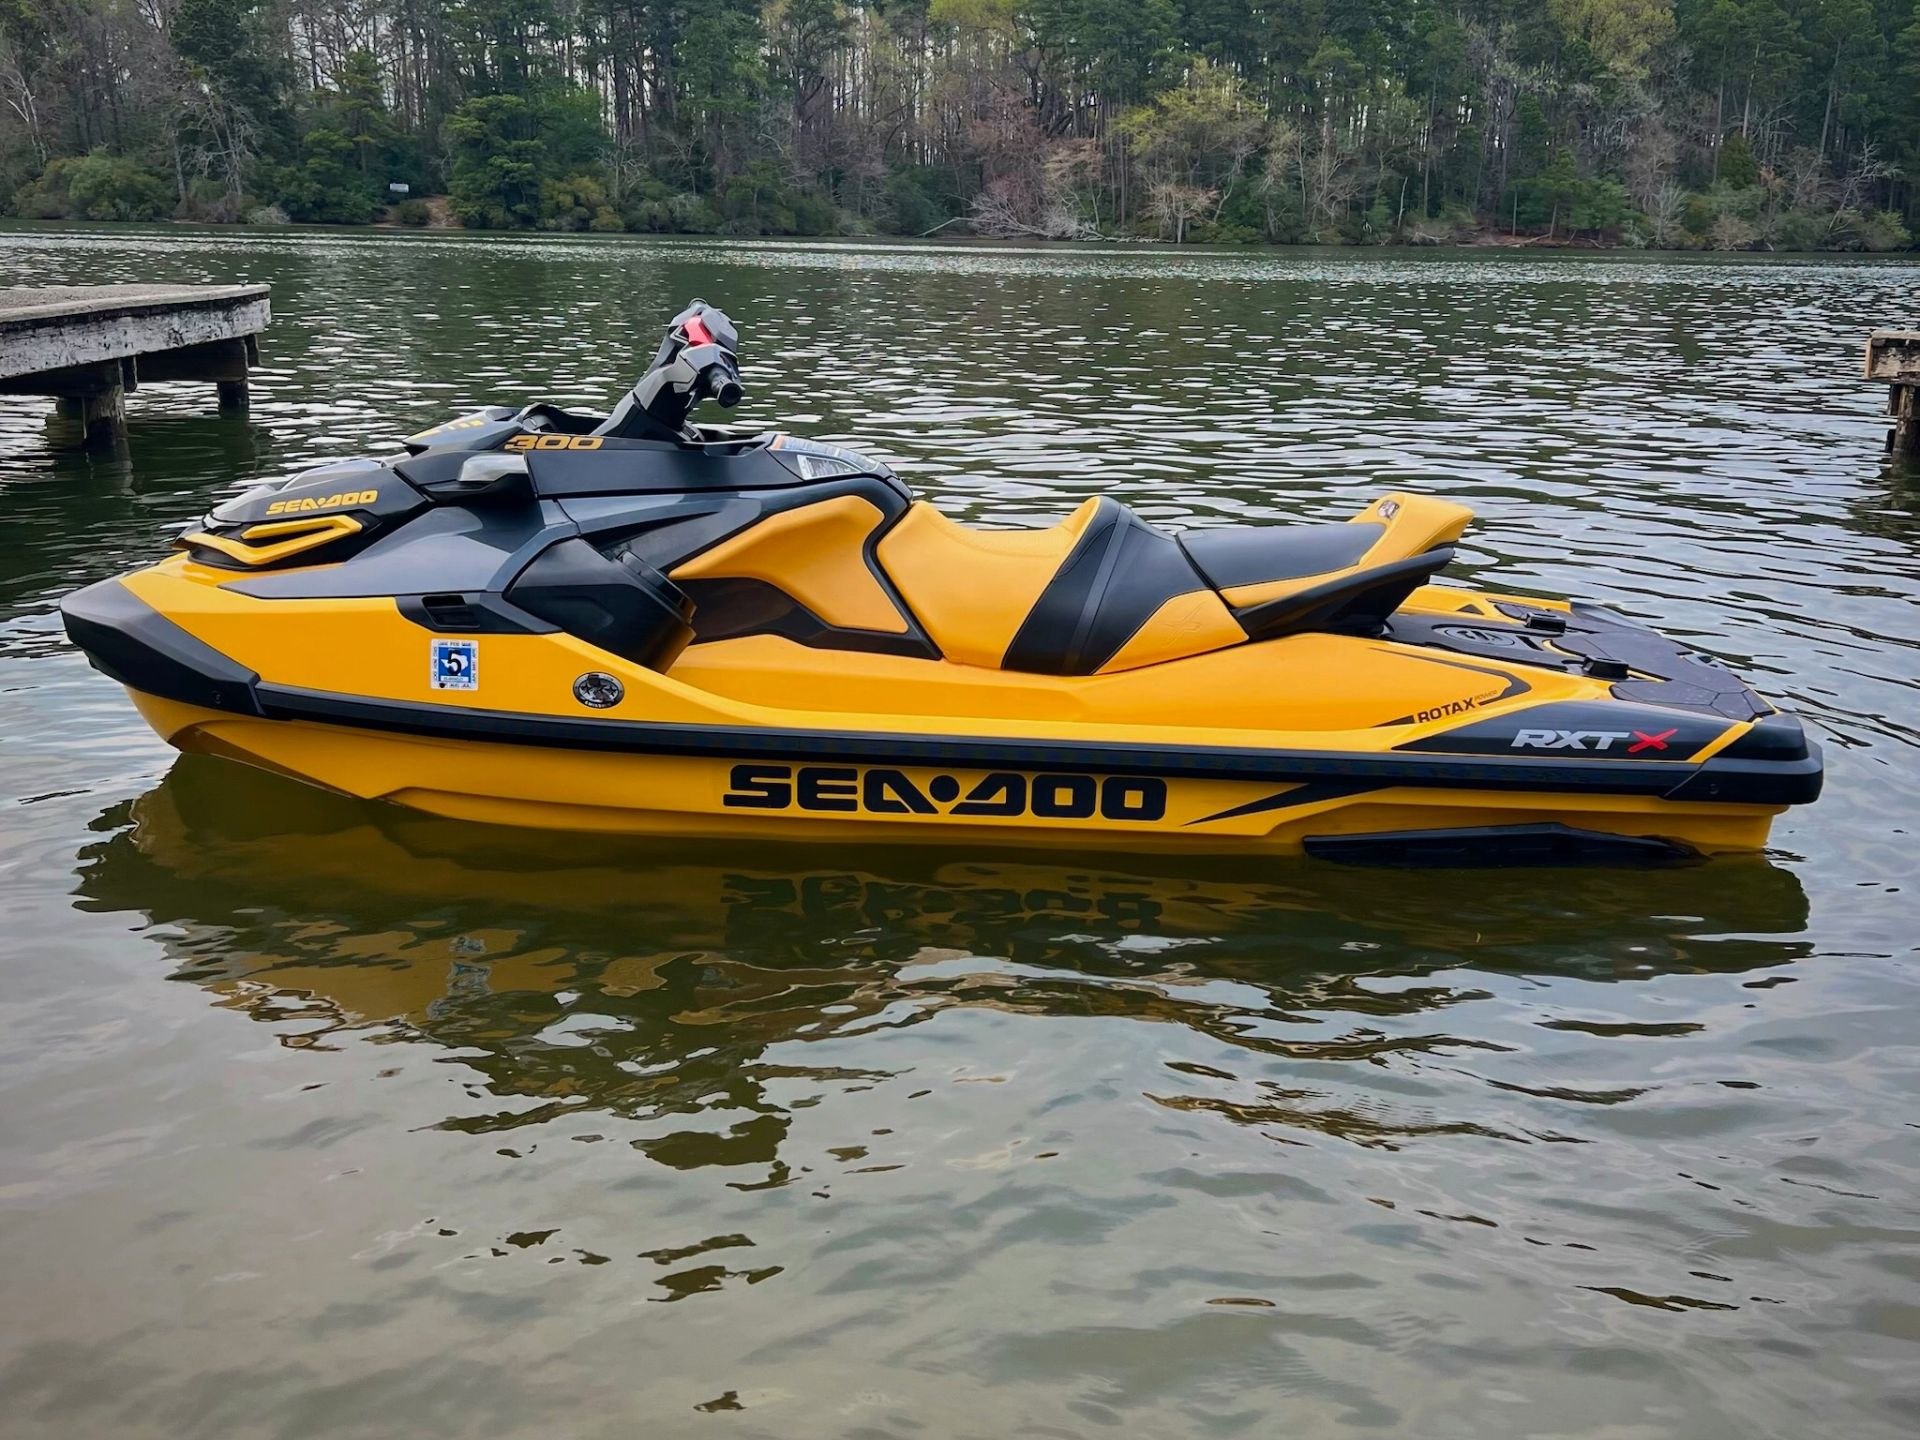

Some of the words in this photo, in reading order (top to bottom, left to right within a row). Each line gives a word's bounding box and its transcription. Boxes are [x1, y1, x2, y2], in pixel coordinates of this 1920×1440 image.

[504, 434, 604, 450] 300
[446, 648, 462, 677] 5
[1417, 697, 1476, 723] ROTAX
